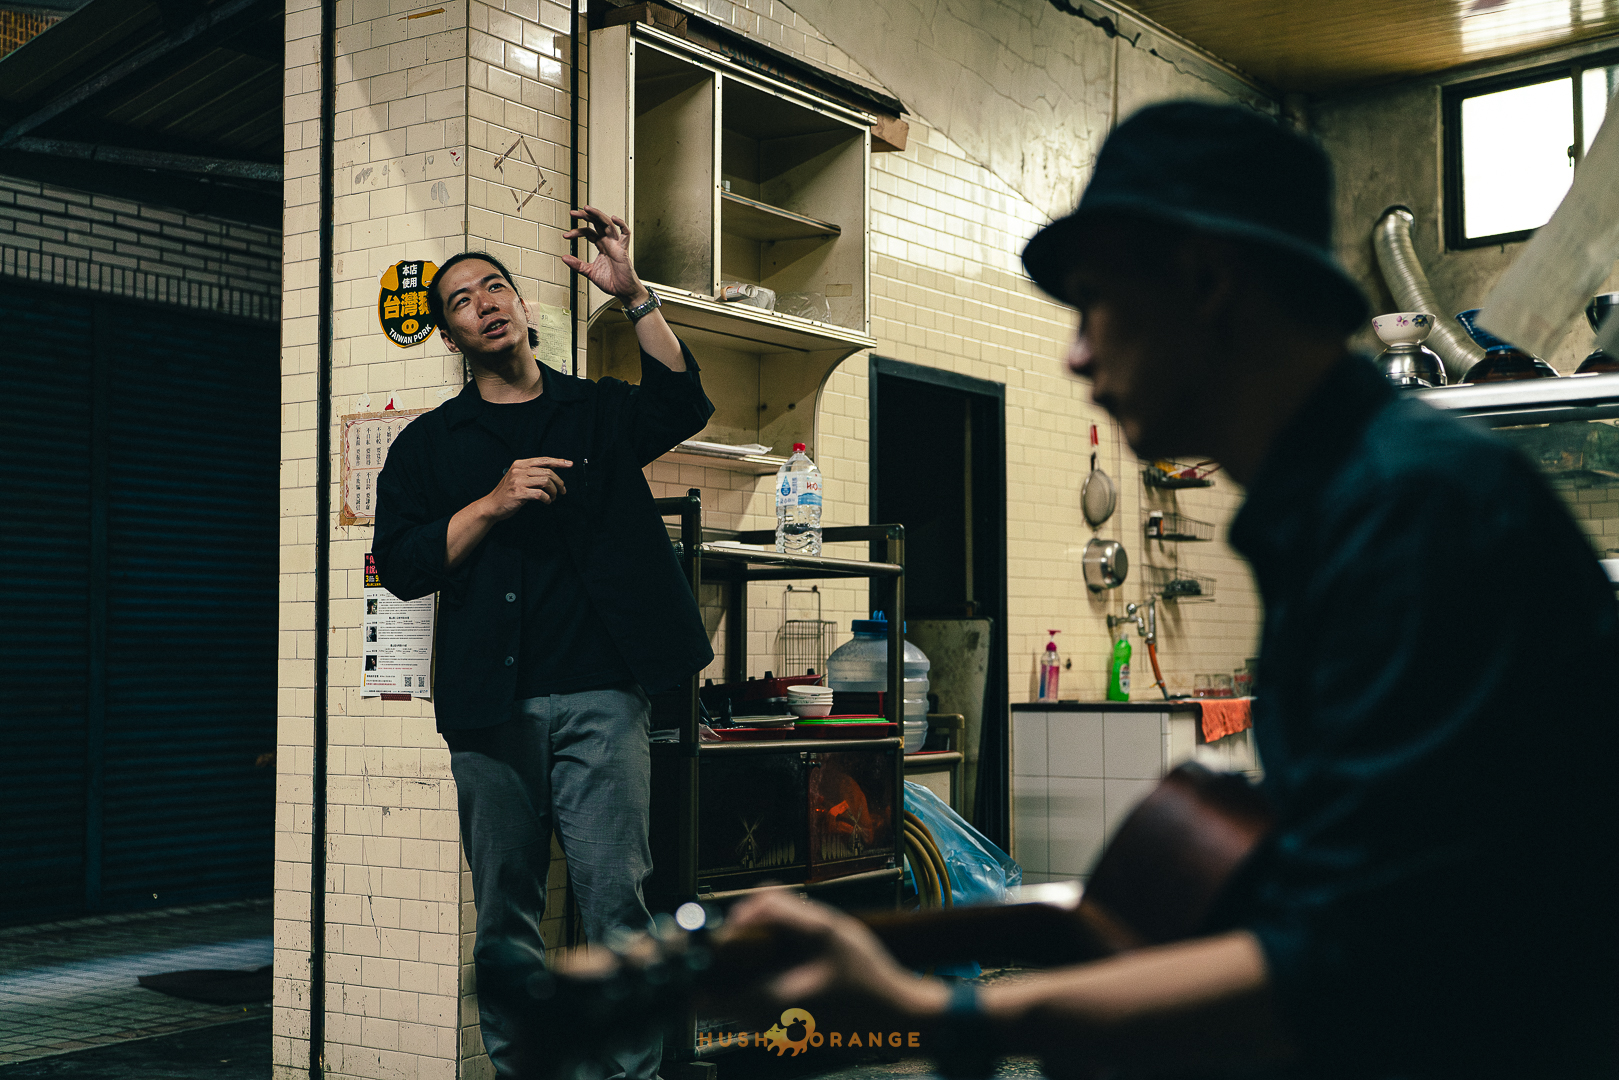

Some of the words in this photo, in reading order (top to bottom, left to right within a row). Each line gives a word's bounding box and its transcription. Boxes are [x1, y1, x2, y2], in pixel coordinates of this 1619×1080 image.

[402, 264, 418, 276] 本店
[402, 277, 418, 289] 使用
[389, 327, 413, 344] TAIWAN
[413, 323, 432, 342] PORK
